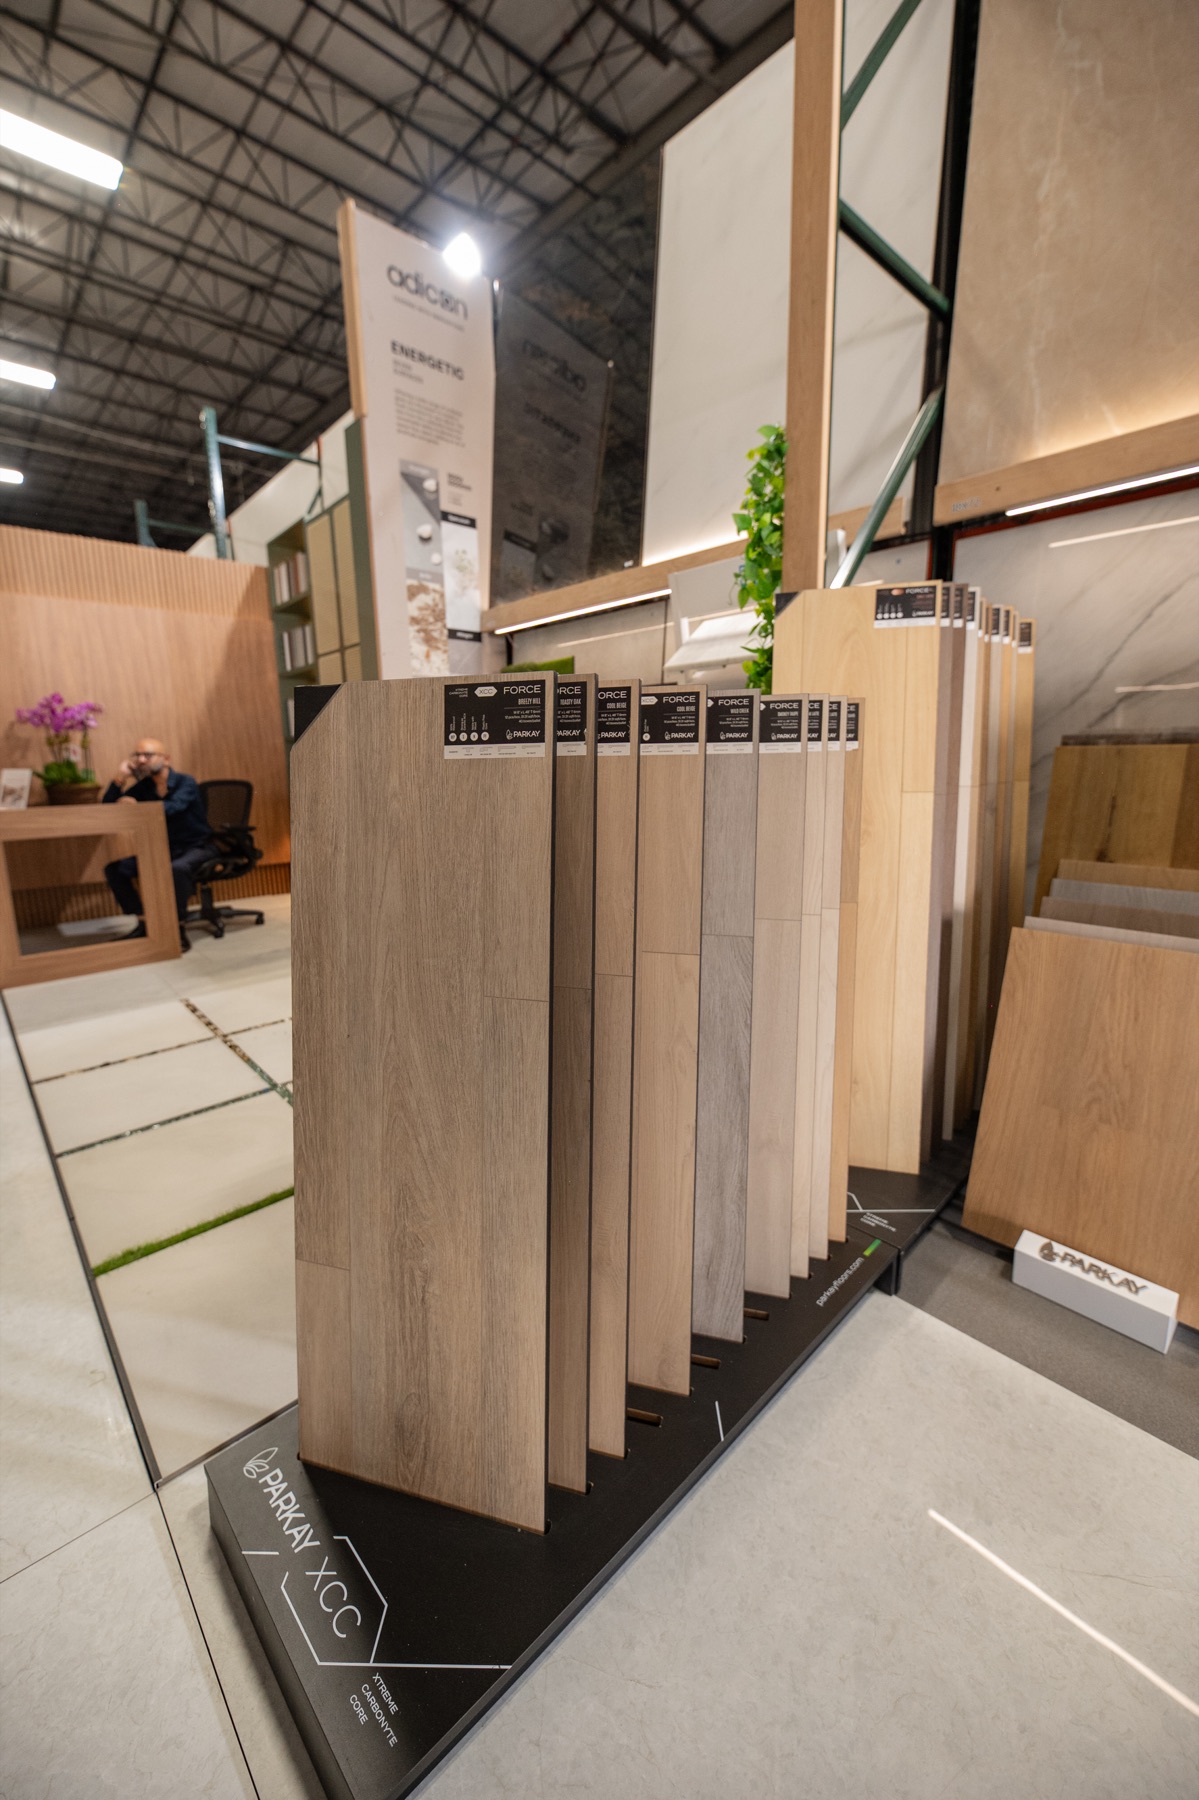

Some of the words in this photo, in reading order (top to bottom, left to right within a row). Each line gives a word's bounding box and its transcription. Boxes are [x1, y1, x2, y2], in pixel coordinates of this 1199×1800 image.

[503, 684, 541, 694] FORCE
[557, 686, 581, 694] RCE
[598, 691, 627, 699] ORCE
[816, 1257, 864, 1307] parkayfloors.com
[1060, 1251, 1148, 1295] PARKAY
[258, 1468, 320, 1553] PARKAY
[305, 1556, 362, 1638] XCC
[350, 1695, 368, 1725] CORE
[372, 1672, 398, 1714] XTREME
[362, 1684, 398, 1747] CARBONYTE
